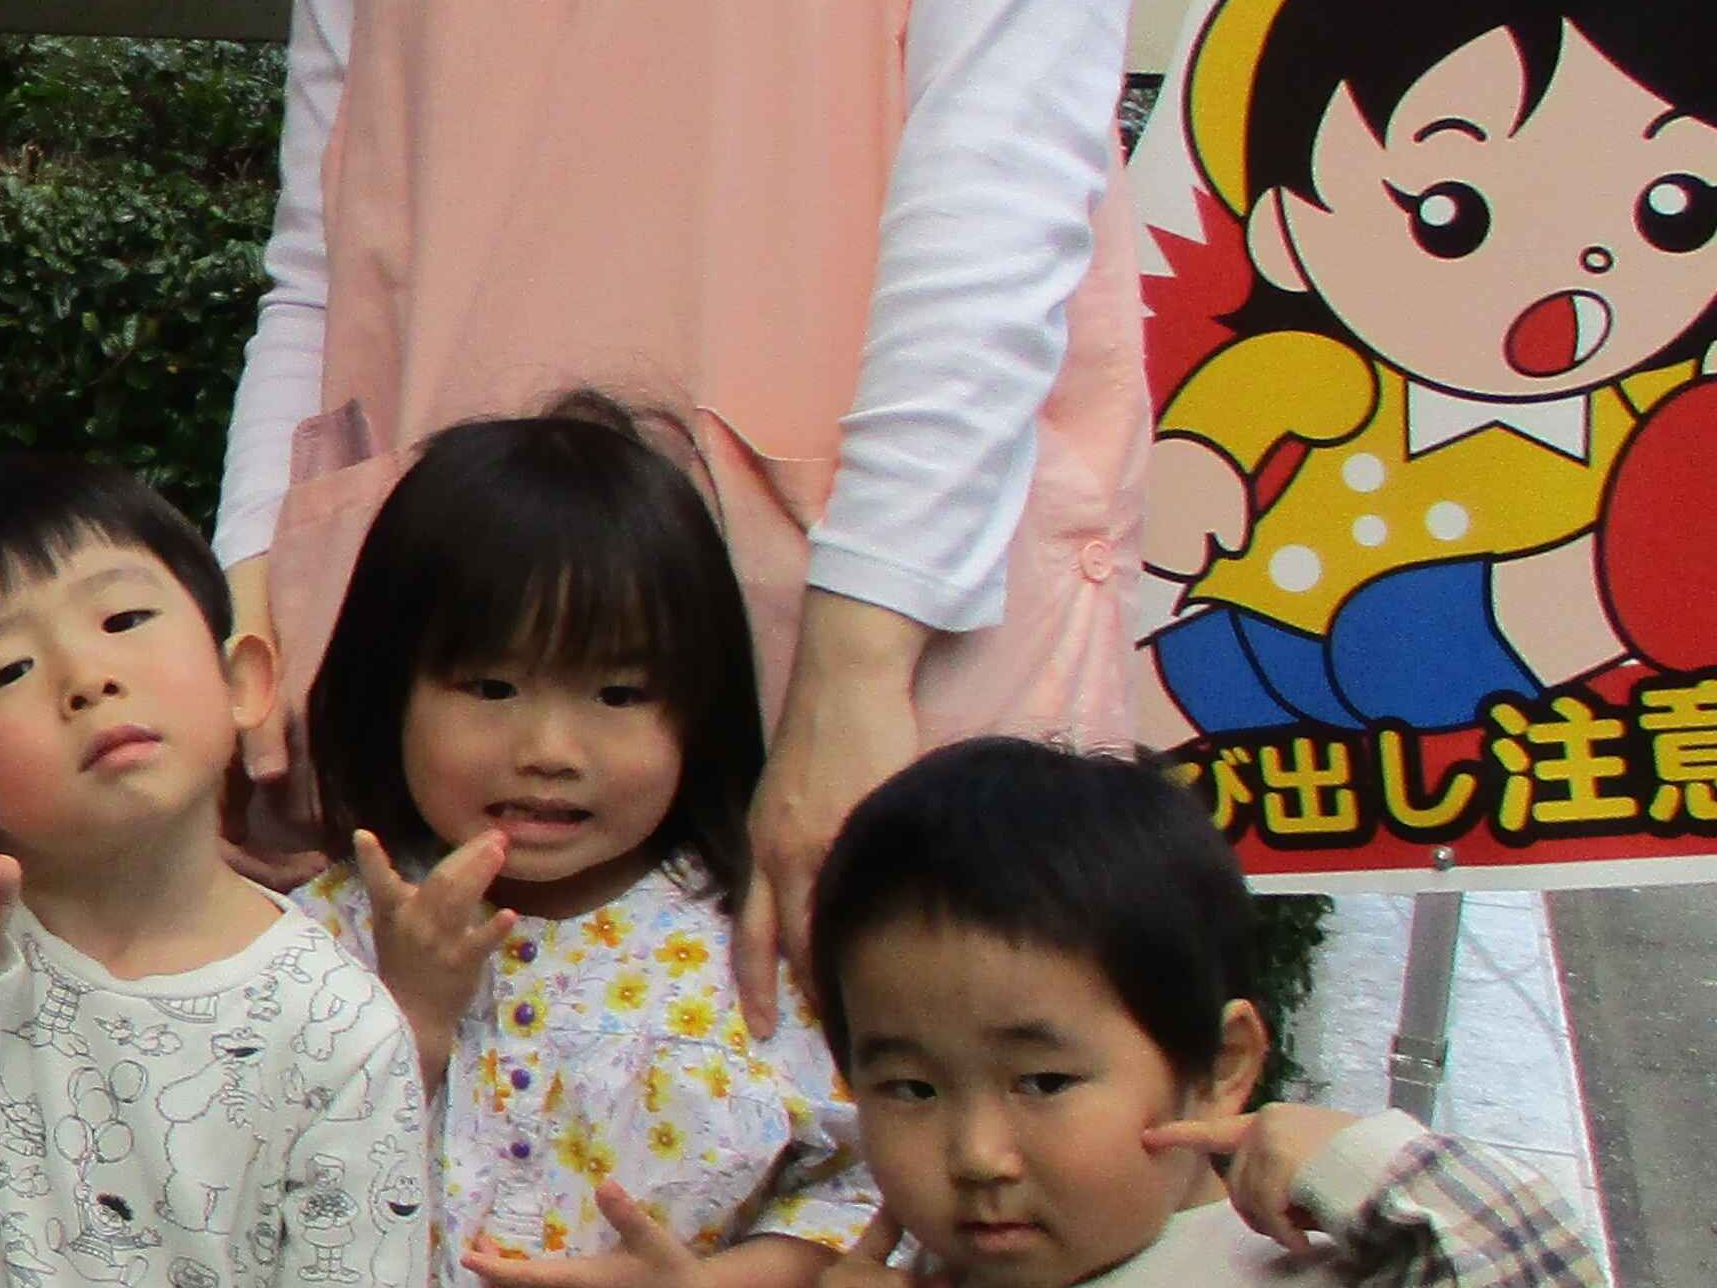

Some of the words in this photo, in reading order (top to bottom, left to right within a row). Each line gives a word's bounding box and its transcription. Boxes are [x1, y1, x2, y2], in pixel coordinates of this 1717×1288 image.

[1168, 679, 1717, 834] び出し注意
